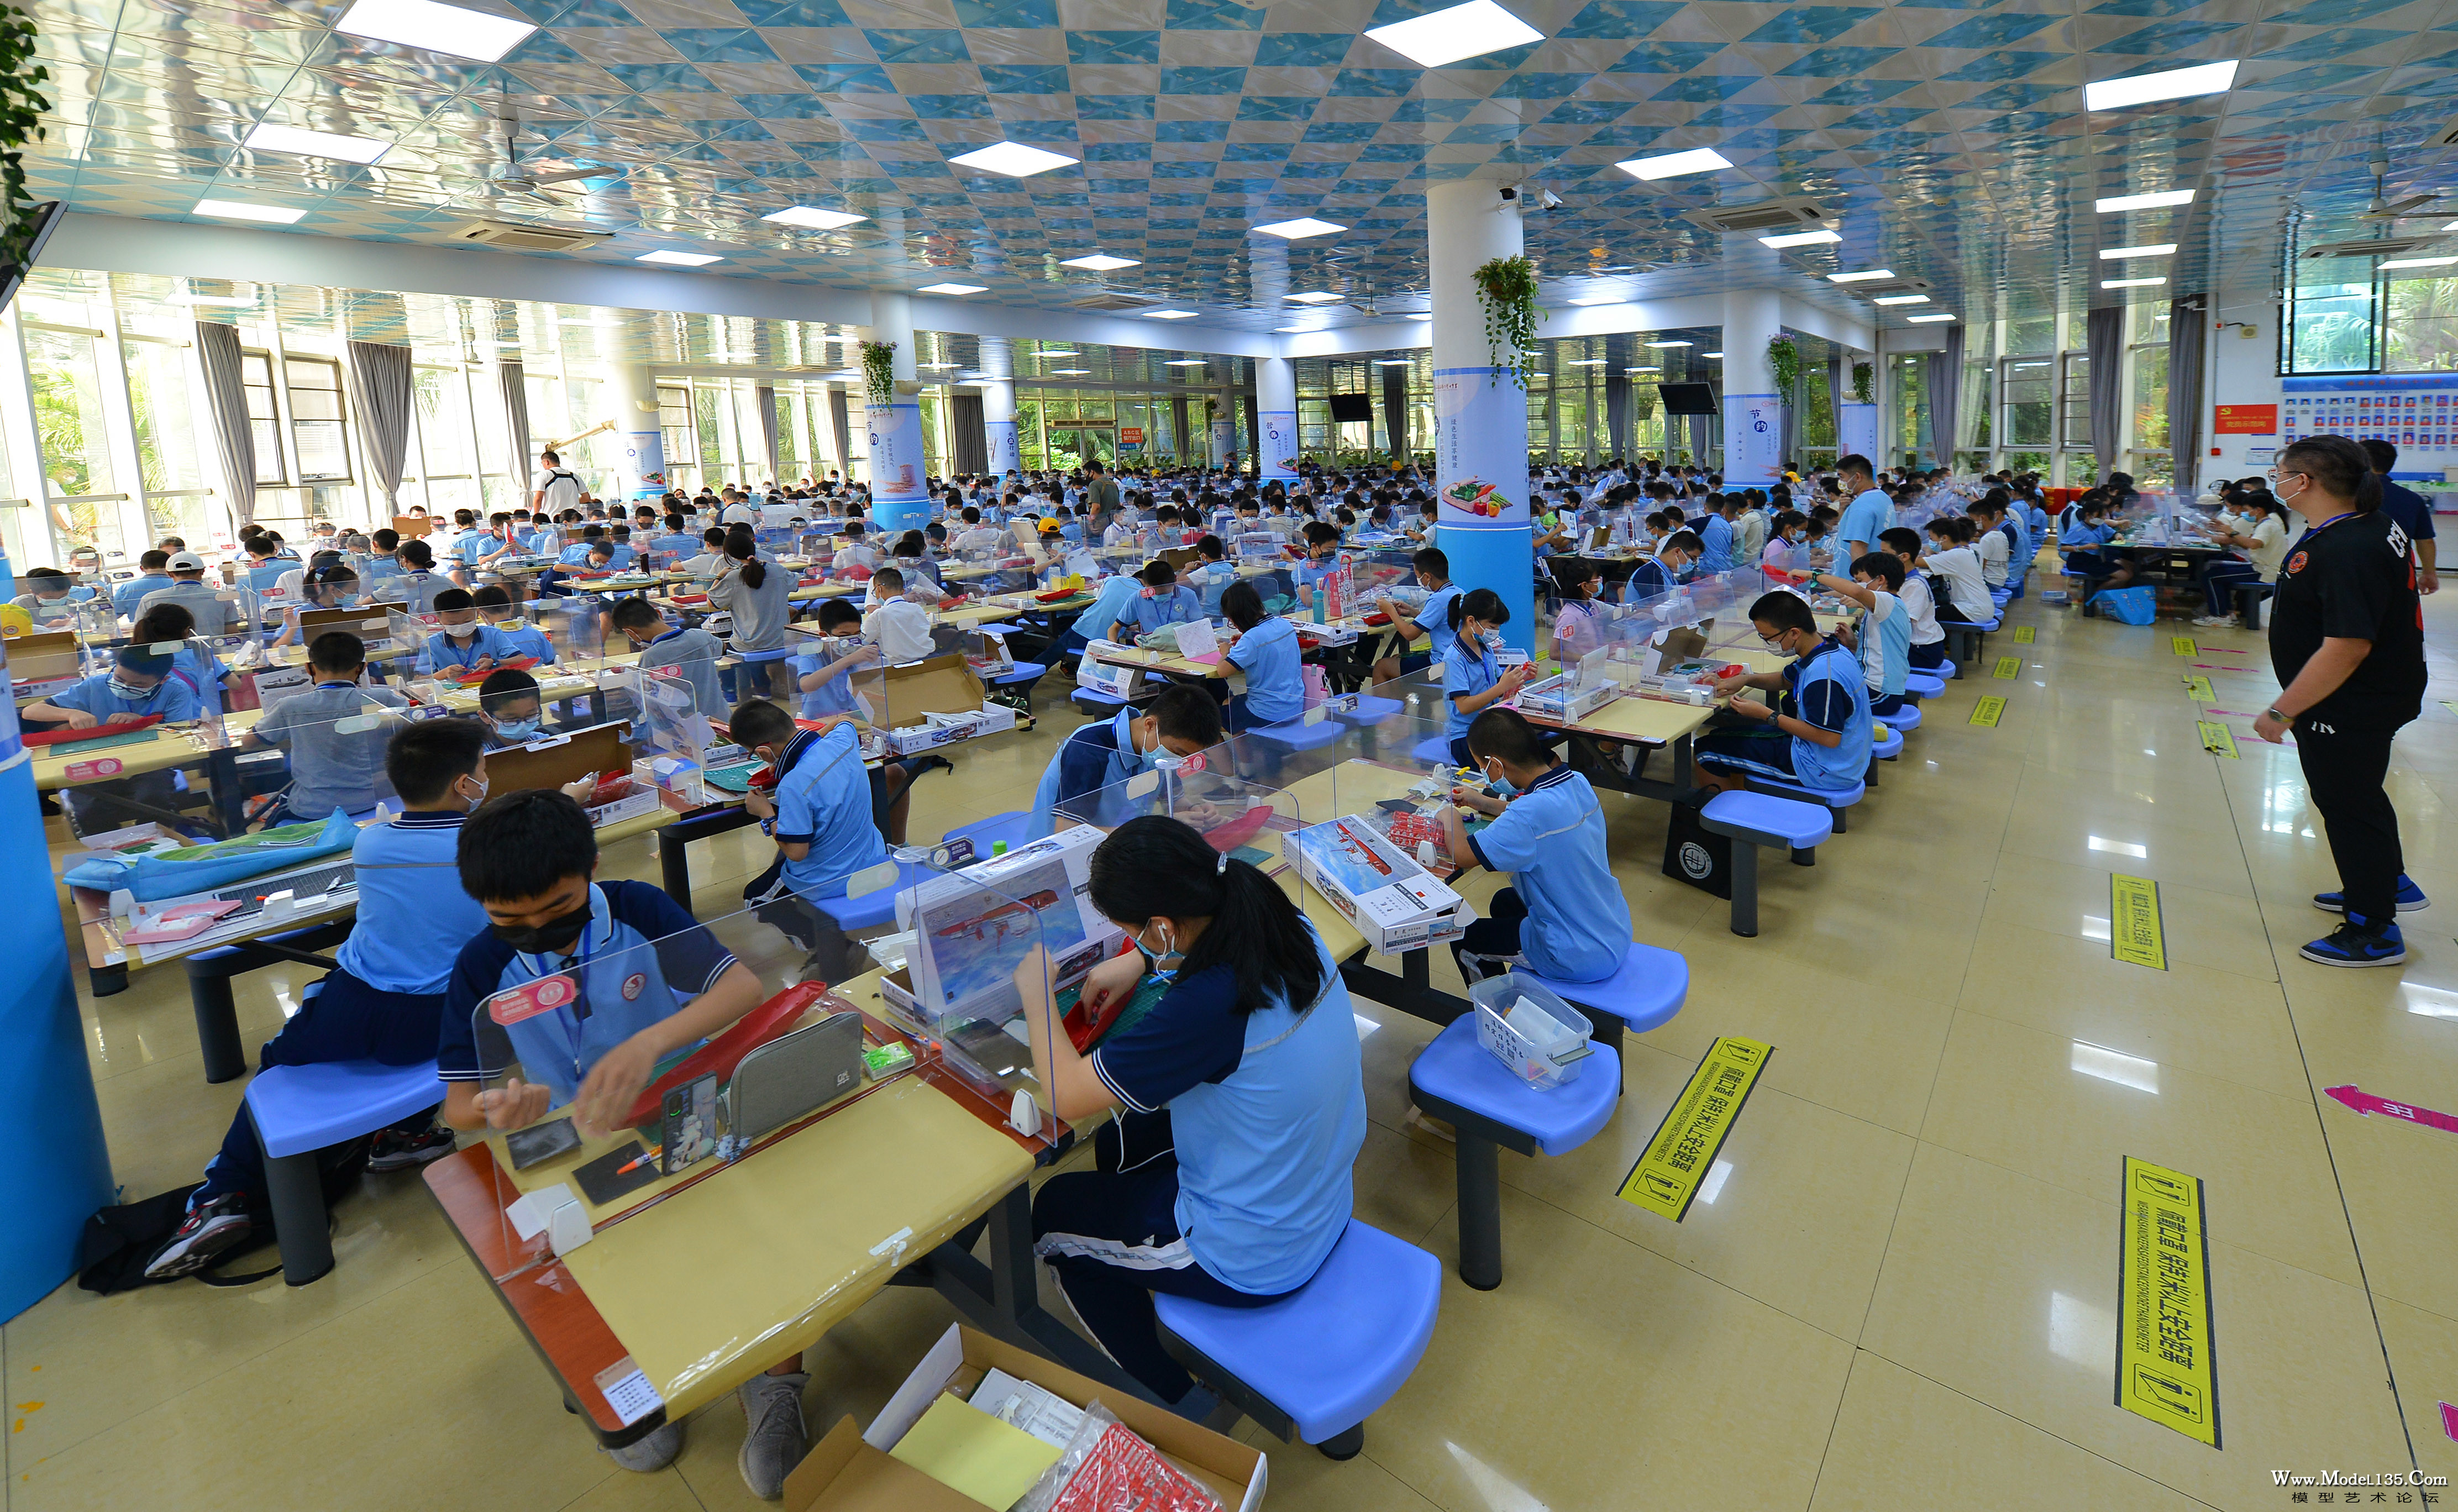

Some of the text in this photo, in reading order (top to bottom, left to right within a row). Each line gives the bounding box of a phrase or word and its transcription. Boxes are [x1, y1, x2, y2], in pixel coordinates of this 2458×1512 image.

[1668, 1065, 1746, 1173] 佩戴口罩 保持1米以上安全距离
[2155, 1206, 2195, 1372] 佩戴口罩 保持1米以上安全距离
